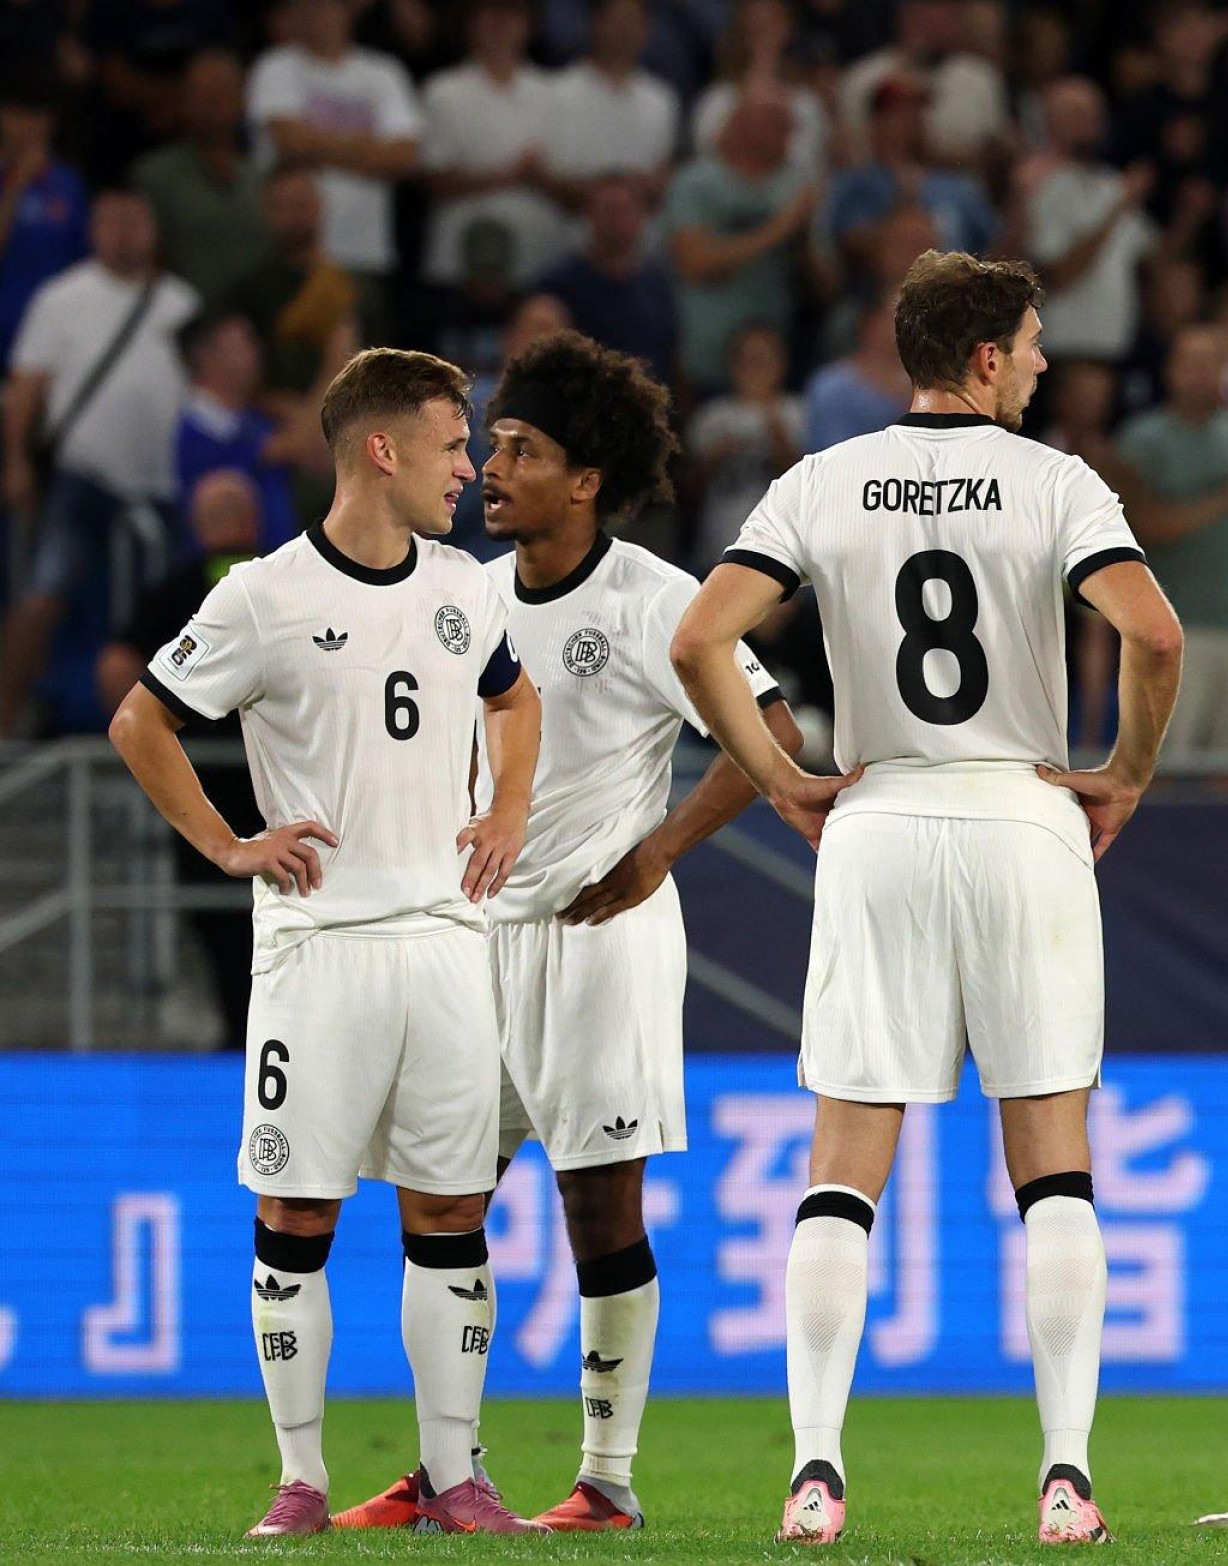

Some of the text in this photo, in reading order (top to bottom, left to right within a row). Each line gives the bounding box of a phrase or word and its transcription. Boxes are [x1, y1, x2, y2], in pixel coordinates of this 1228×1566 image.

[862, 478, 1002, 516] GORETZKA
[895, 549, 989, 726] 8
[384, 670, 420, 741] 6
[258, 1039, 290, 1111] 6
